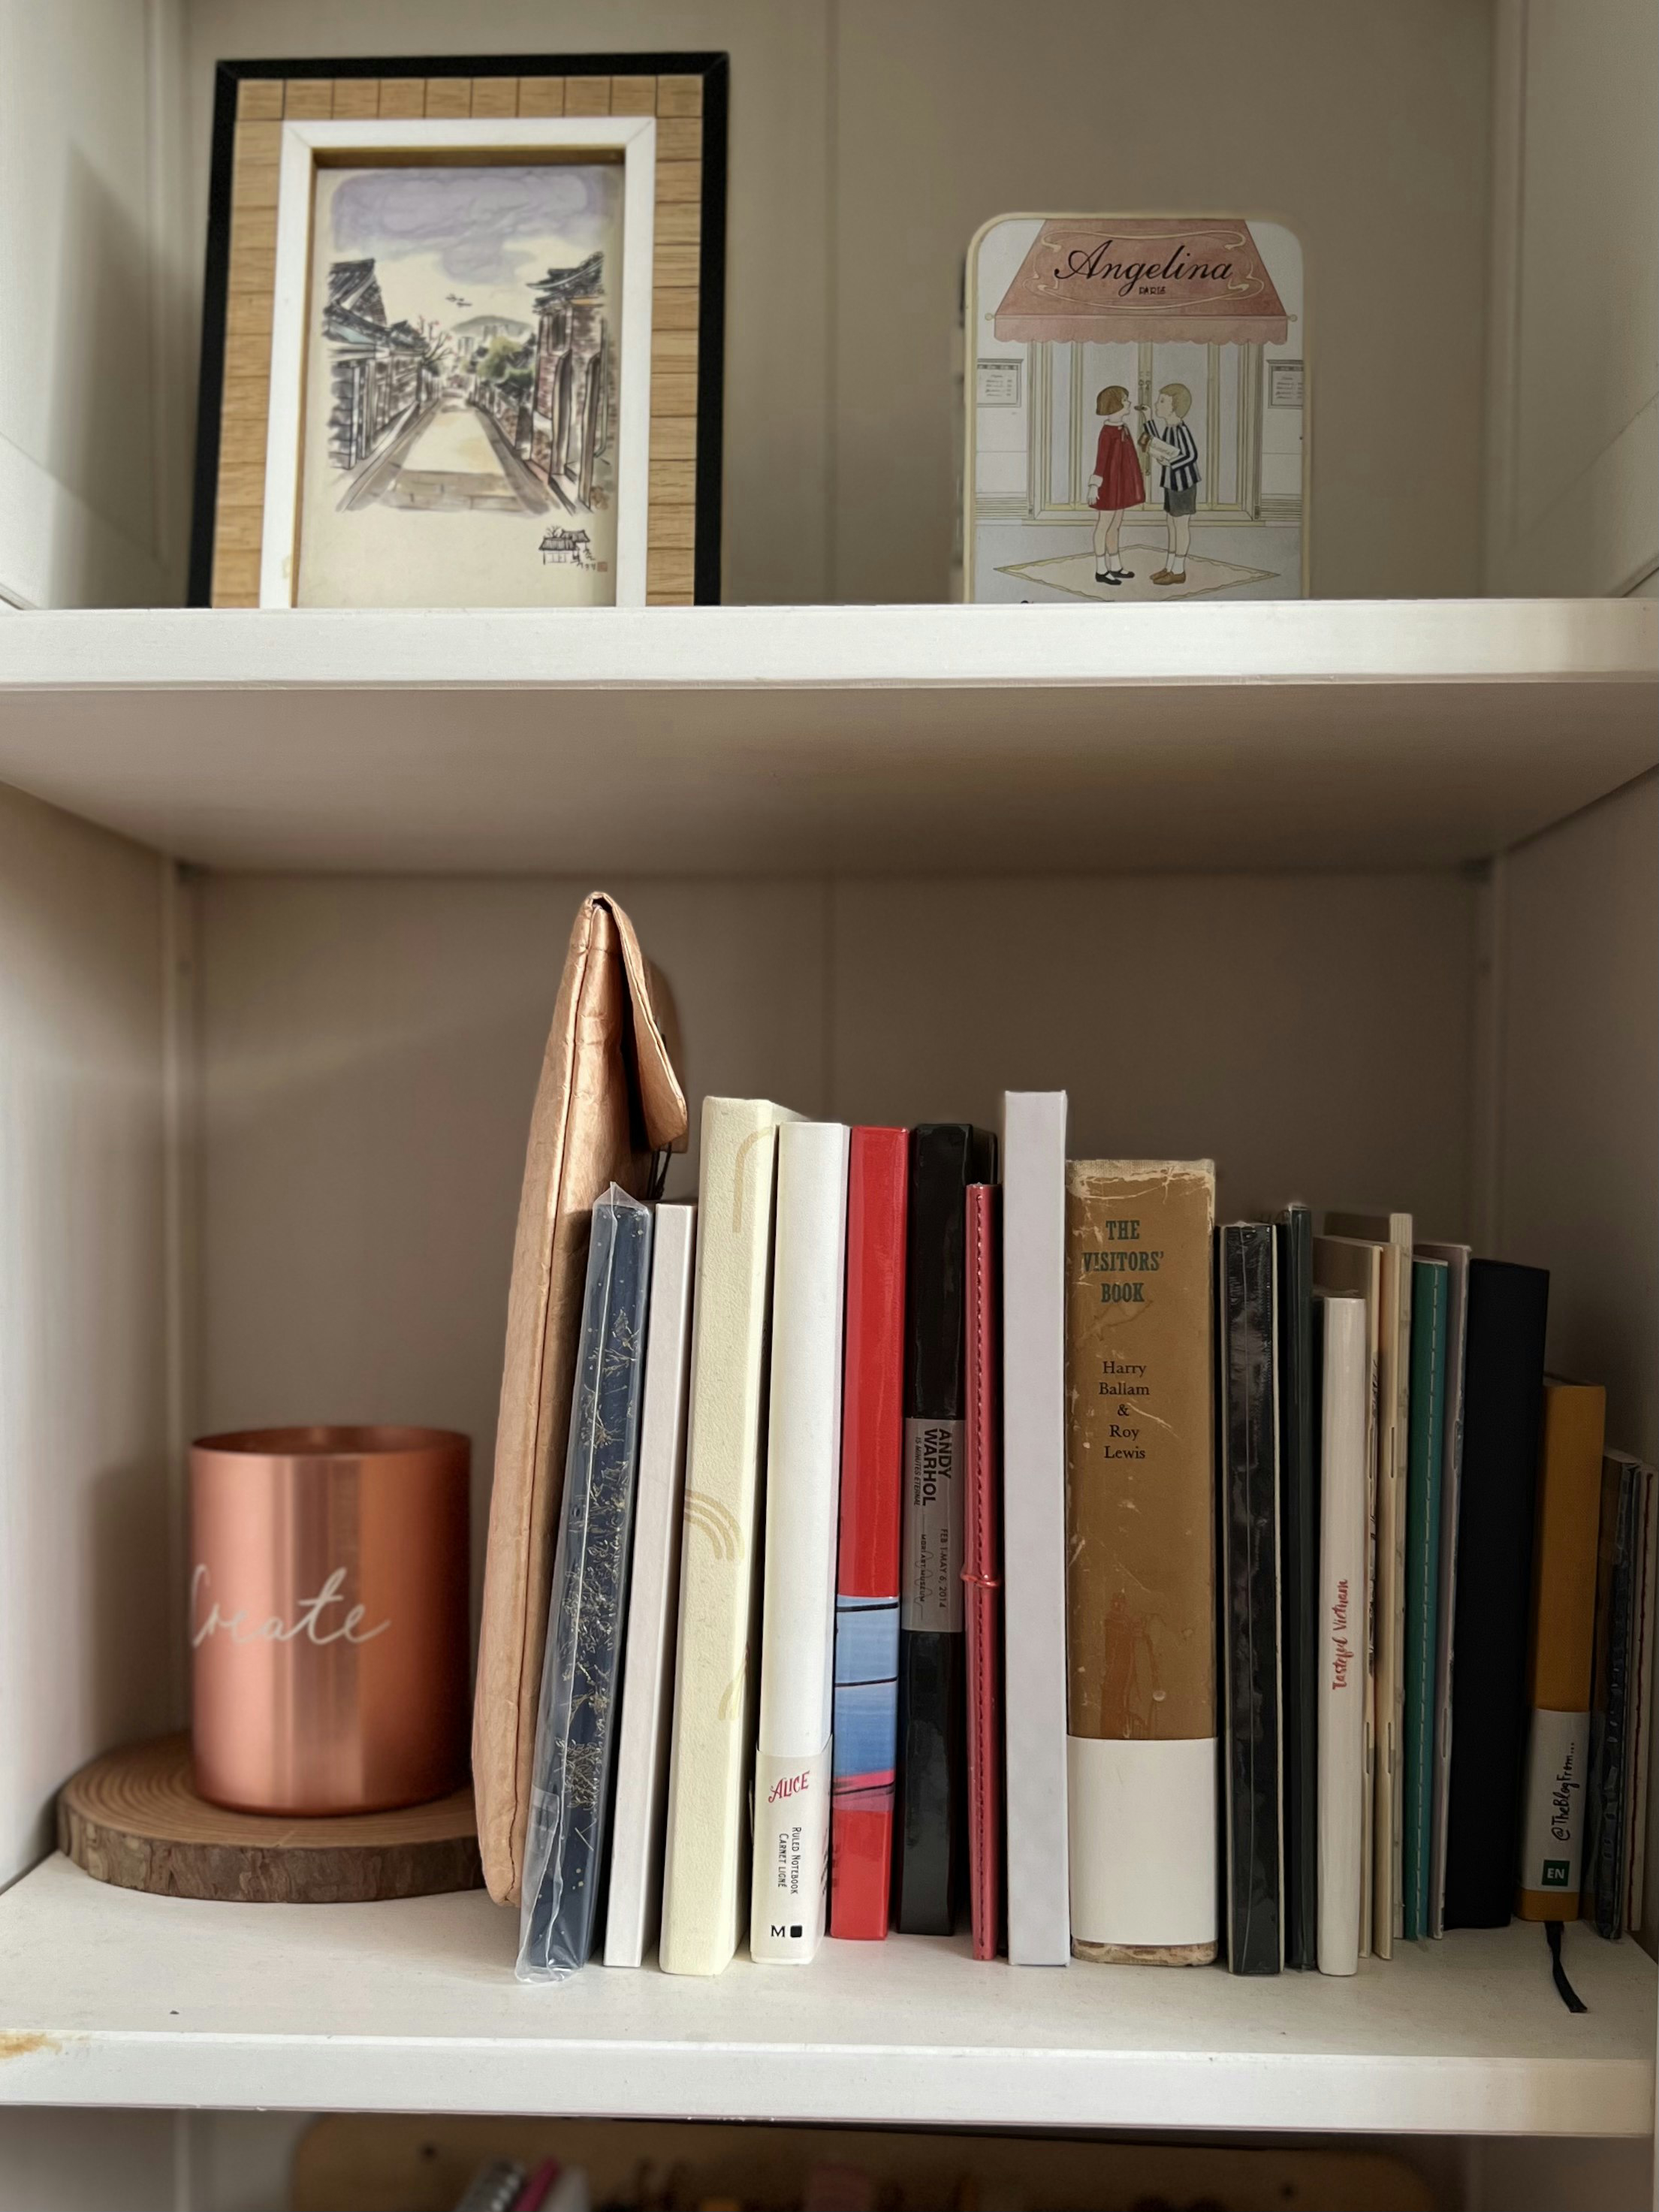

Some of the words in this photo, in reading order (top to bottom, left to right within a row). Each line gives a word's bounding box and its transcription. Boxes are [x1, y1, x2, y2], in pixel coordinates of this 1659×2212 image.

[1054, 240, 1234, 297] Angelina
[1139, 287, 1166, 295] PARIS
[1105, 1220, 1140, 1240] THE
[1081, 1251, 1164, 1272] VISITORS'
[1100, 1283, 1145, 1302] BOOK
[1102, 1360, 1148, 1378] Harry
[1099, 1382, 1150, 1396] Ballam
[1117, 1403, 1130, 1417] &
[1109, 1424, 1140, 1441] Roy
[939, 1429, 952, 1479] ANDY
[1104, 1444, 1146, 1459] Lewis
[922, 1429, 937, 1506] WARHOL
[939, 1586, 947, 1607] 2014
[1332, 1579, 1349, 1631] Vietnam
[1332, 1637, 1354, 1690] Tasteful
[768, 1770, 810, 1803] ALICE
[778, 1833, 789, 1863] CARNET
[792, 1827, 802, 1852] RULED
[791, 1854, 801, 1894] NOTEBOOK
[1547, 1868, 1565, 1880] EN
[771, 1925, 786, 1938] M
